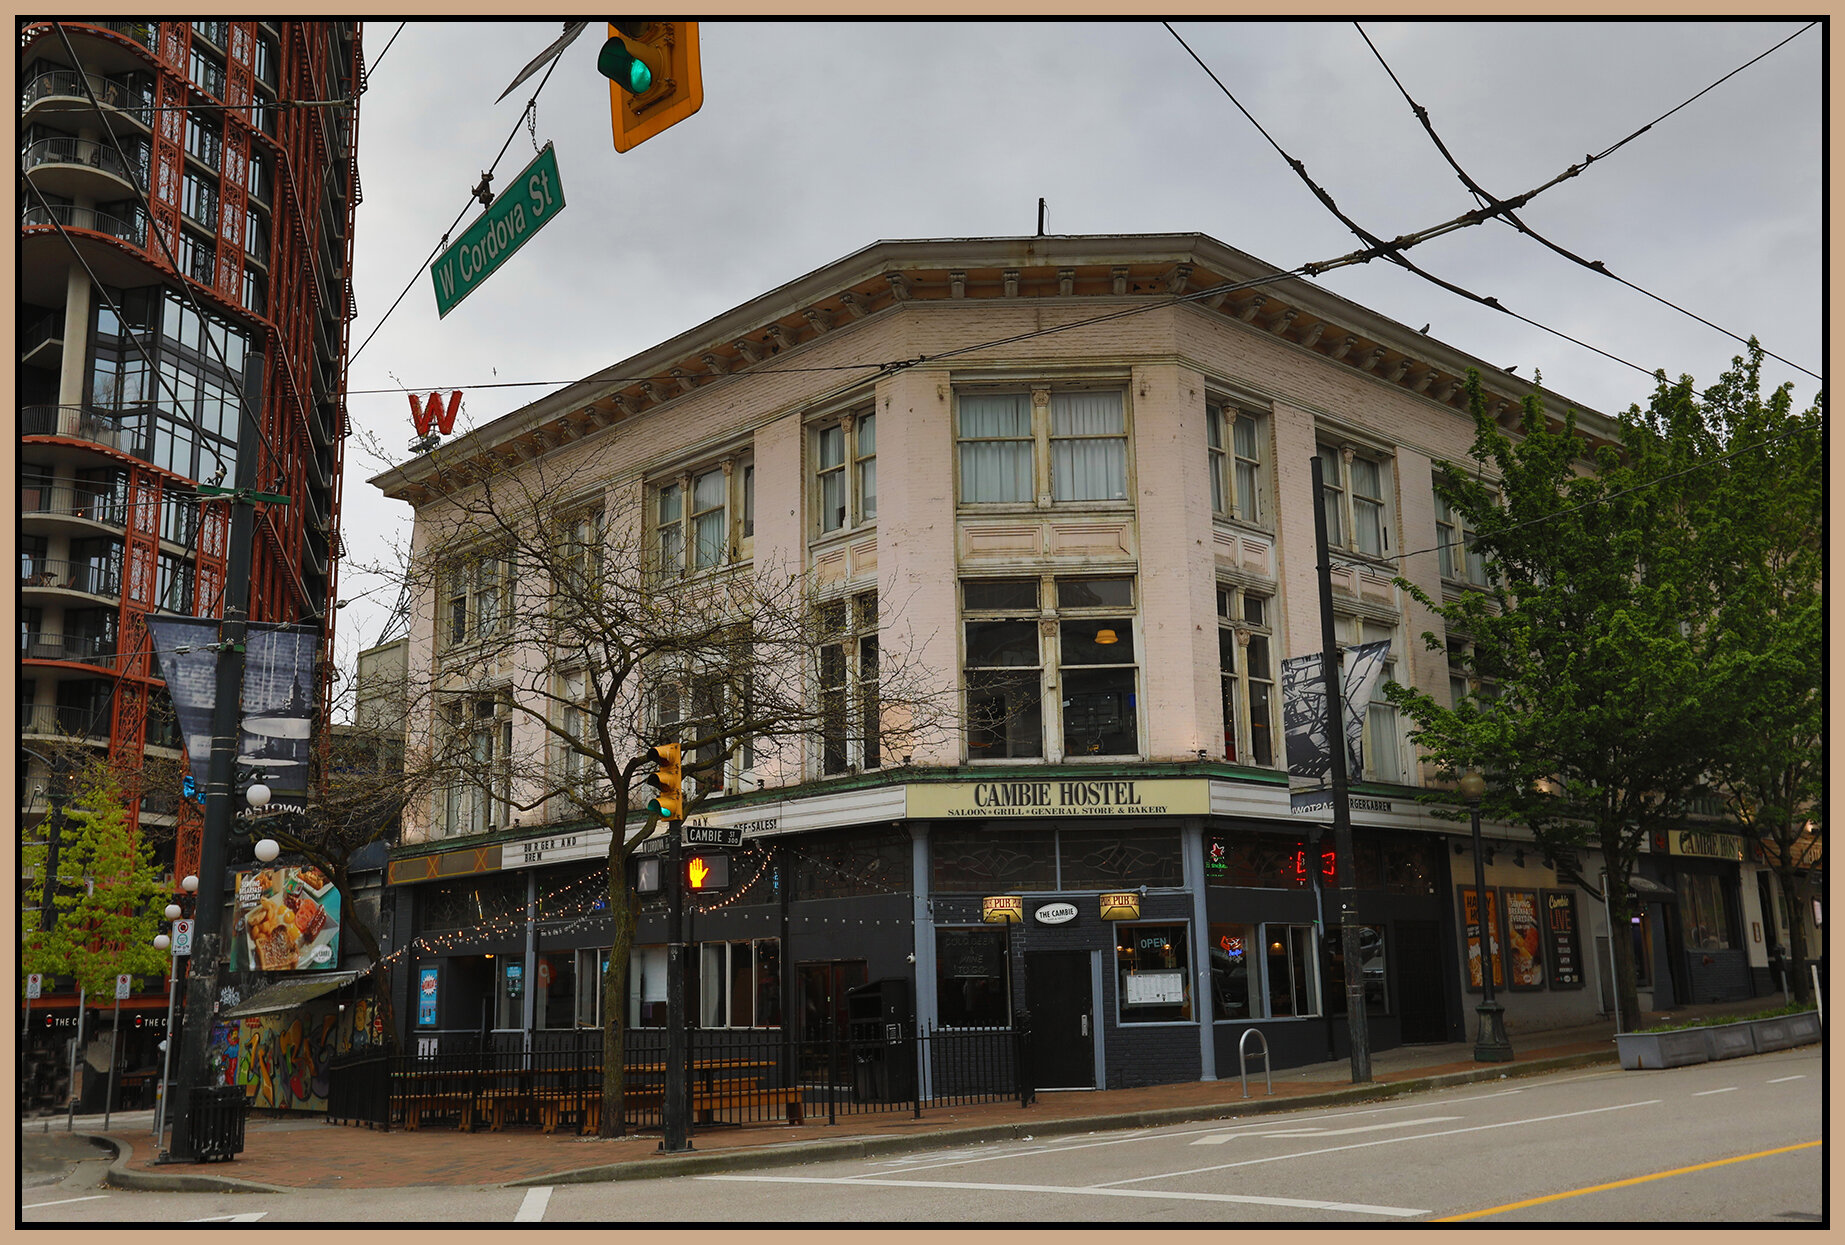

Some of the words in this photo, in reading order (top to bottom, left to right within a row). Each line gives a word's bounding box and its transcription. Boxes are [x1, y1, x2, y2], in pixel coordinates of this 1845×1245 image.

[438, 258, 456, 300] W
[459, 203, 526, 283] Cordova
[528, 168, 553, 217] St
[408, 390, 463, 436] W
[974, 783, 1052, 807] CAMBIE
[1059, 781, 1142, 806] HOSTEL
[236, 803, 306, 819] GASTOWN
[1031, 807, 1080, 815] GENERAL
[1081, 807, 1114, 815] STORE
[1128, 806, 1168, 814] BAKERY
[690, 829, 723, 842] CAMBIE
[1679, 831, 1718, 856] CAMBIE
[994, 898, 1010, 908] PUB
[1113, 896, 1129, 905] PUB
[1467, 896, 1491, 908] HAY
[1051, 908, 1074, 917] CAMBIE
[1550, 909, 1572, 930] LIVE
[1141, 937, 1167, 949] OPEN
[55, 1017, 70, 1027] THE
[145, 1018, 158, 1028] THE
